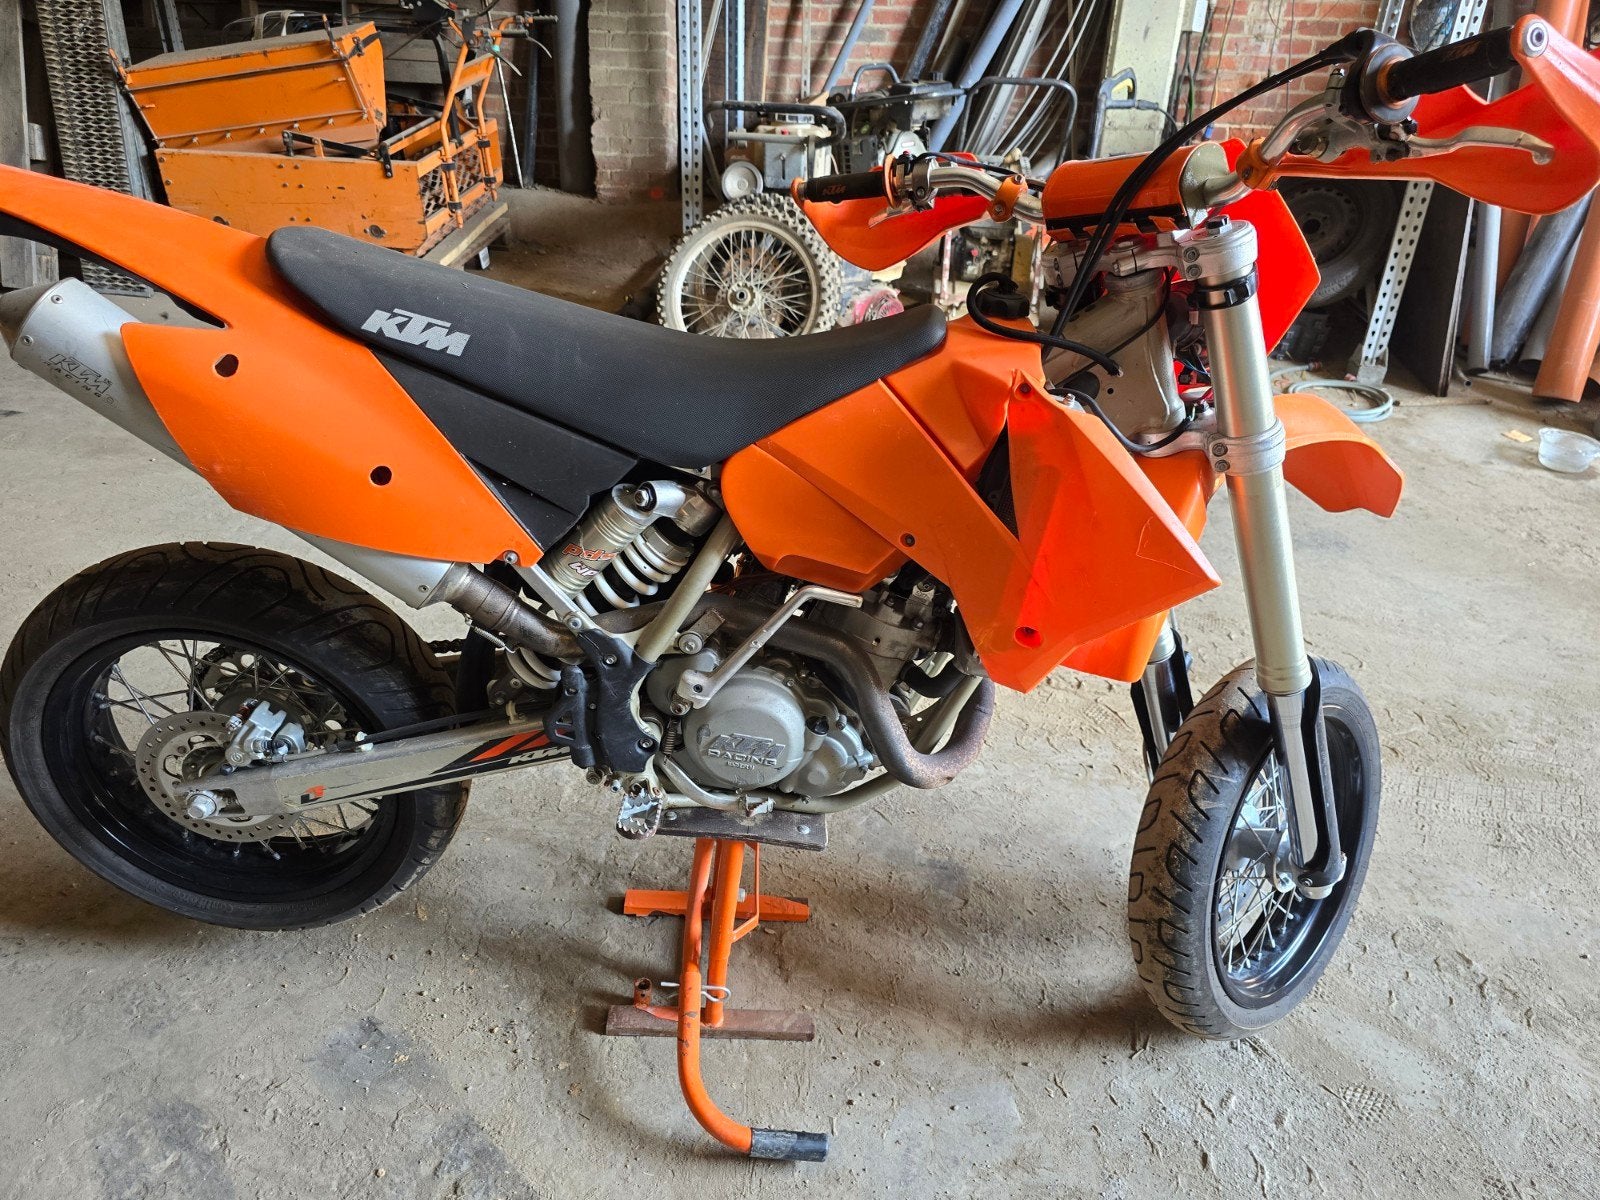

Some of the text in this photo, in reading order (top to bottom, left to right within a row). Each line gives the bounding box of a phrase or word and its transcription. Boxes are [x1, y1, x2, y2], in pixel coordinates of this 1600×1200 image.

[361, 308, 471, 357] KTM
[43, 361, 102, 398] RACING
[48, 353, 111, 395] KTM
[707, 748, 778, 767] RACING
[711, 733, 786, 759] KTM
